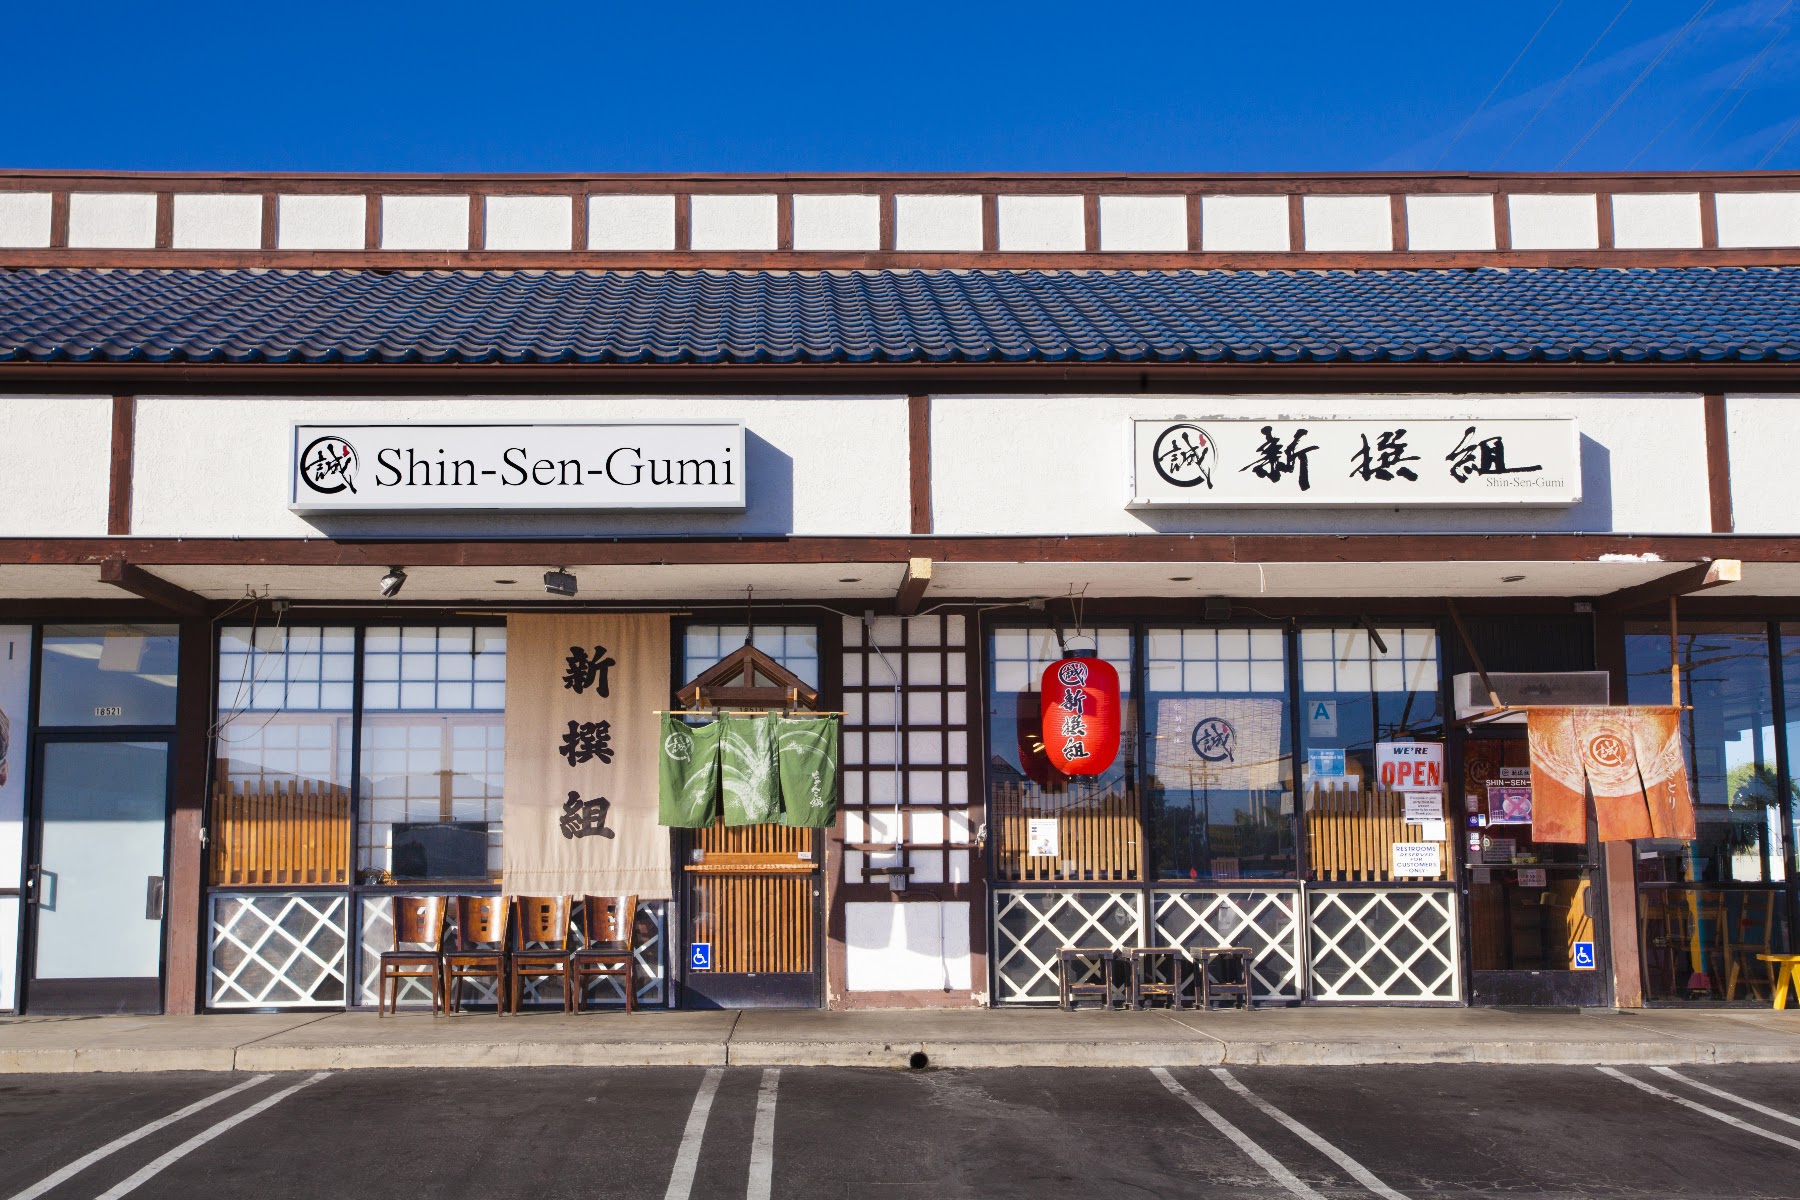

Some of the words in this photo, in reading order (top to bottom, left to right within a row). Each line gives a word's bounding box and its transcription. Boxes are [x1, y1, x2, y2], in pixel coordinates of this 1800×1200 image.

[375, 447, 735, 486] Shin-Sen-Gumi
[1239, 426, 1542, 491] 新撰組
[1486, 477, 1564, 488] Shin-Sen-Gumi
[96, 707, 120, 716] 18521
[1059, 688, 1090, 760] 新撰組
[1314, 703, 1330, 719] A
[559, 646, 616, 839] 新撰組
[1393, 747, 1429, 755] WE'RE
[1381, 761, 1440, 786] OPEN
[1663, 752, 1677, 810] やきとり
